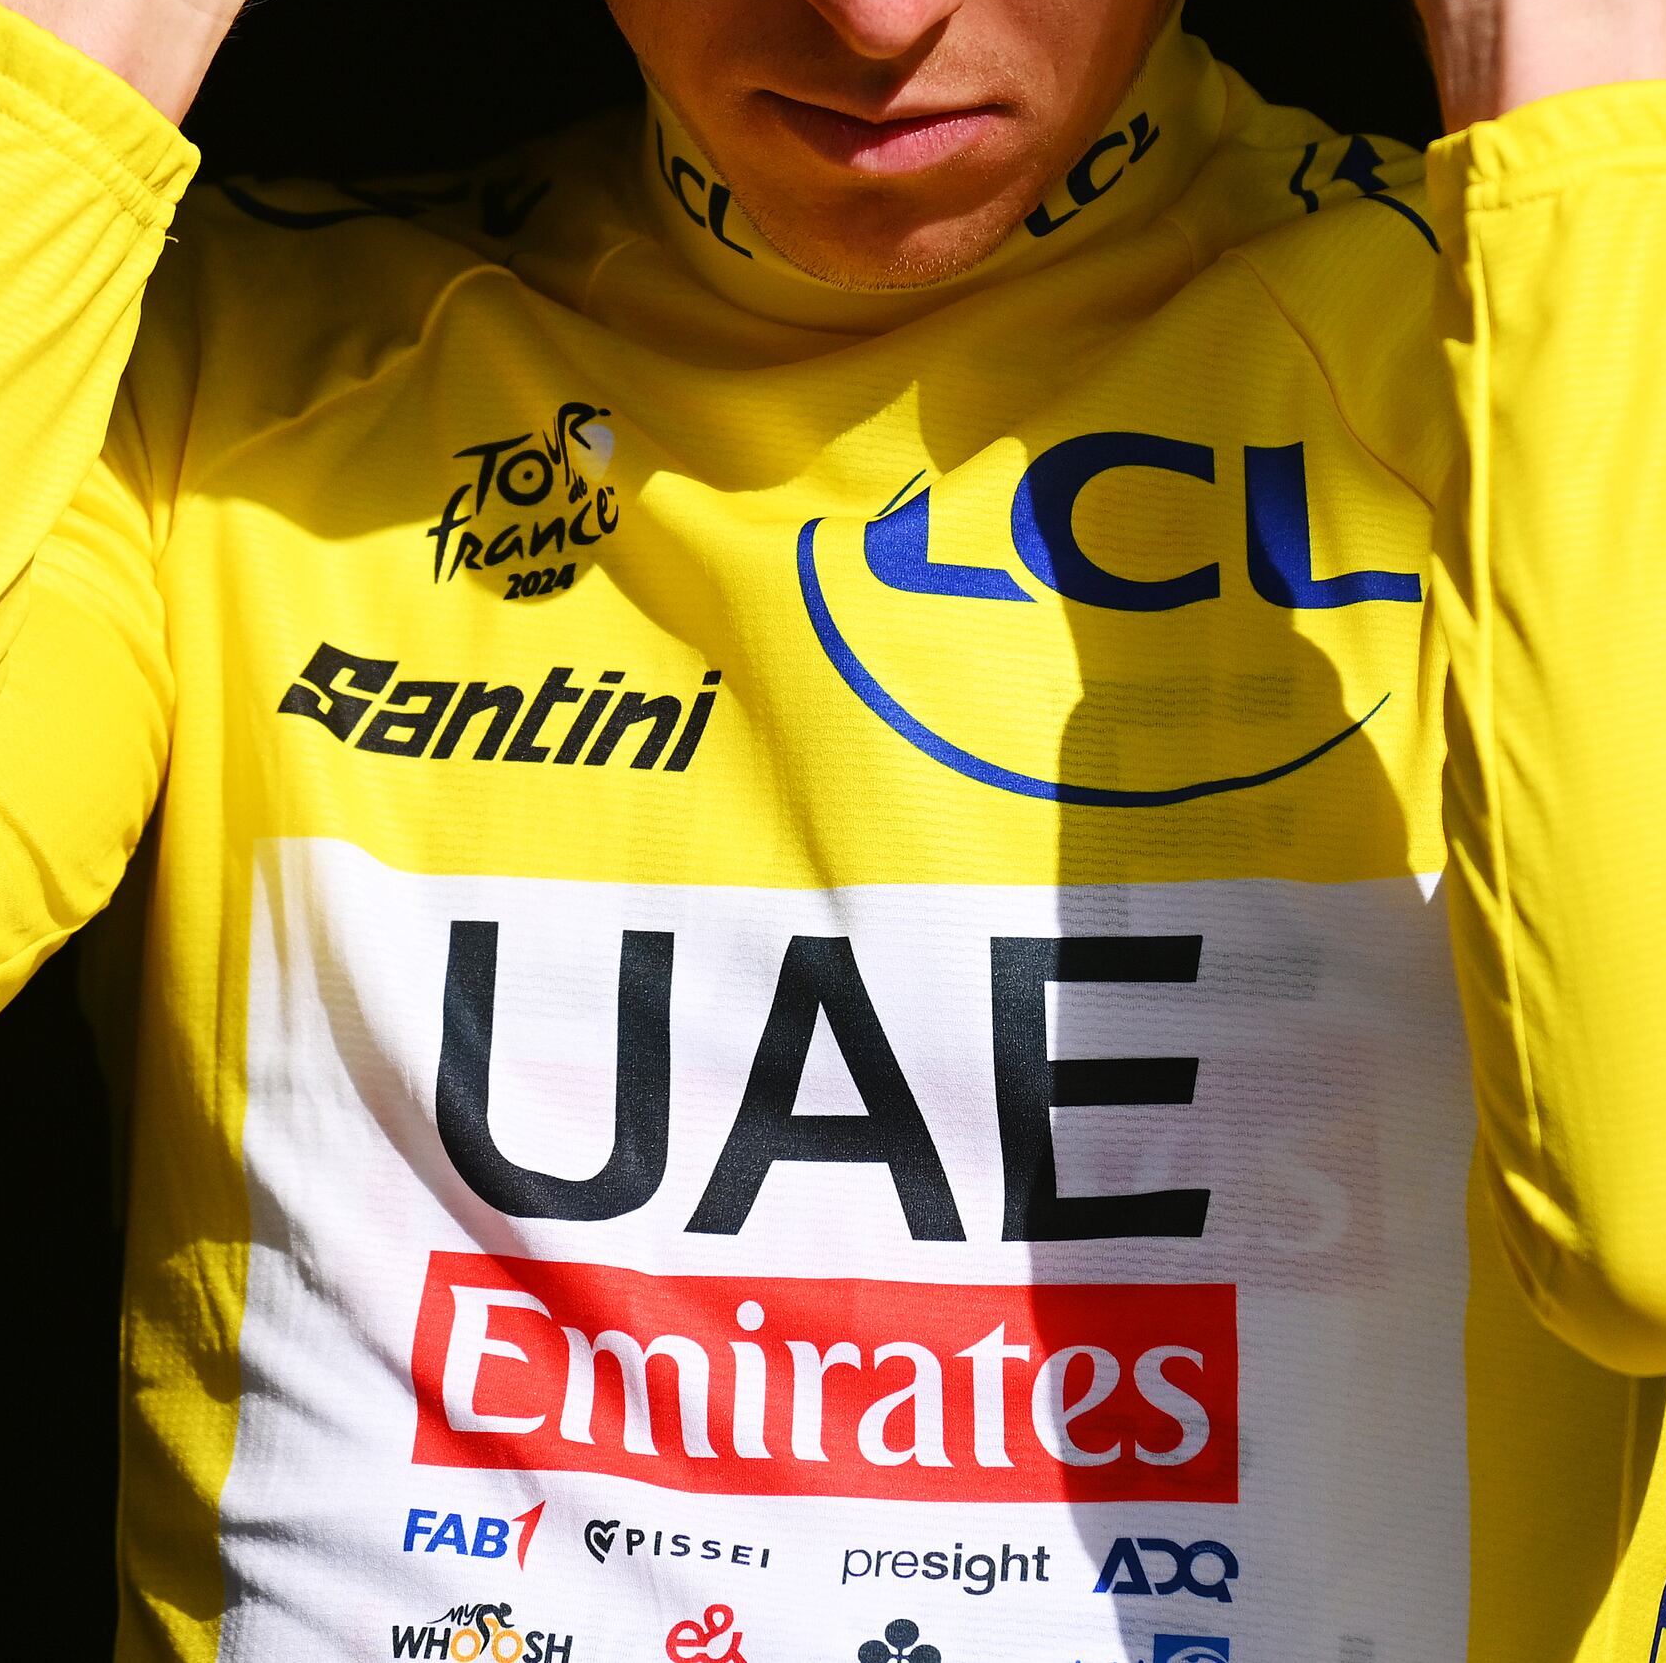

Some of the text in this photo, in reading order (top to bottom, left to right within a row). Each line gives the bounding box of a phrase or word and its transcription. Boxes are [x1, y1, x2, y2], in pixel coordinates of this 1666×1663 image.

[1023, 111, 1161, 238] LCL
[863, 431, 1423, 613] LCL
[503, 562, 577, 601] 2024
[277, 642, 723, 773] Santini
[435, 919, 1211, 1243] UAE
[442, 1283, 1212, 1470] Emirates
[626, 1528, 770, 1569] PISSEI
[841, 1542, 1051, 1596] presight
[1093, 1537, 1240, 1603] ADQ
[392, 1624, 574, 1663] WHOOSH
